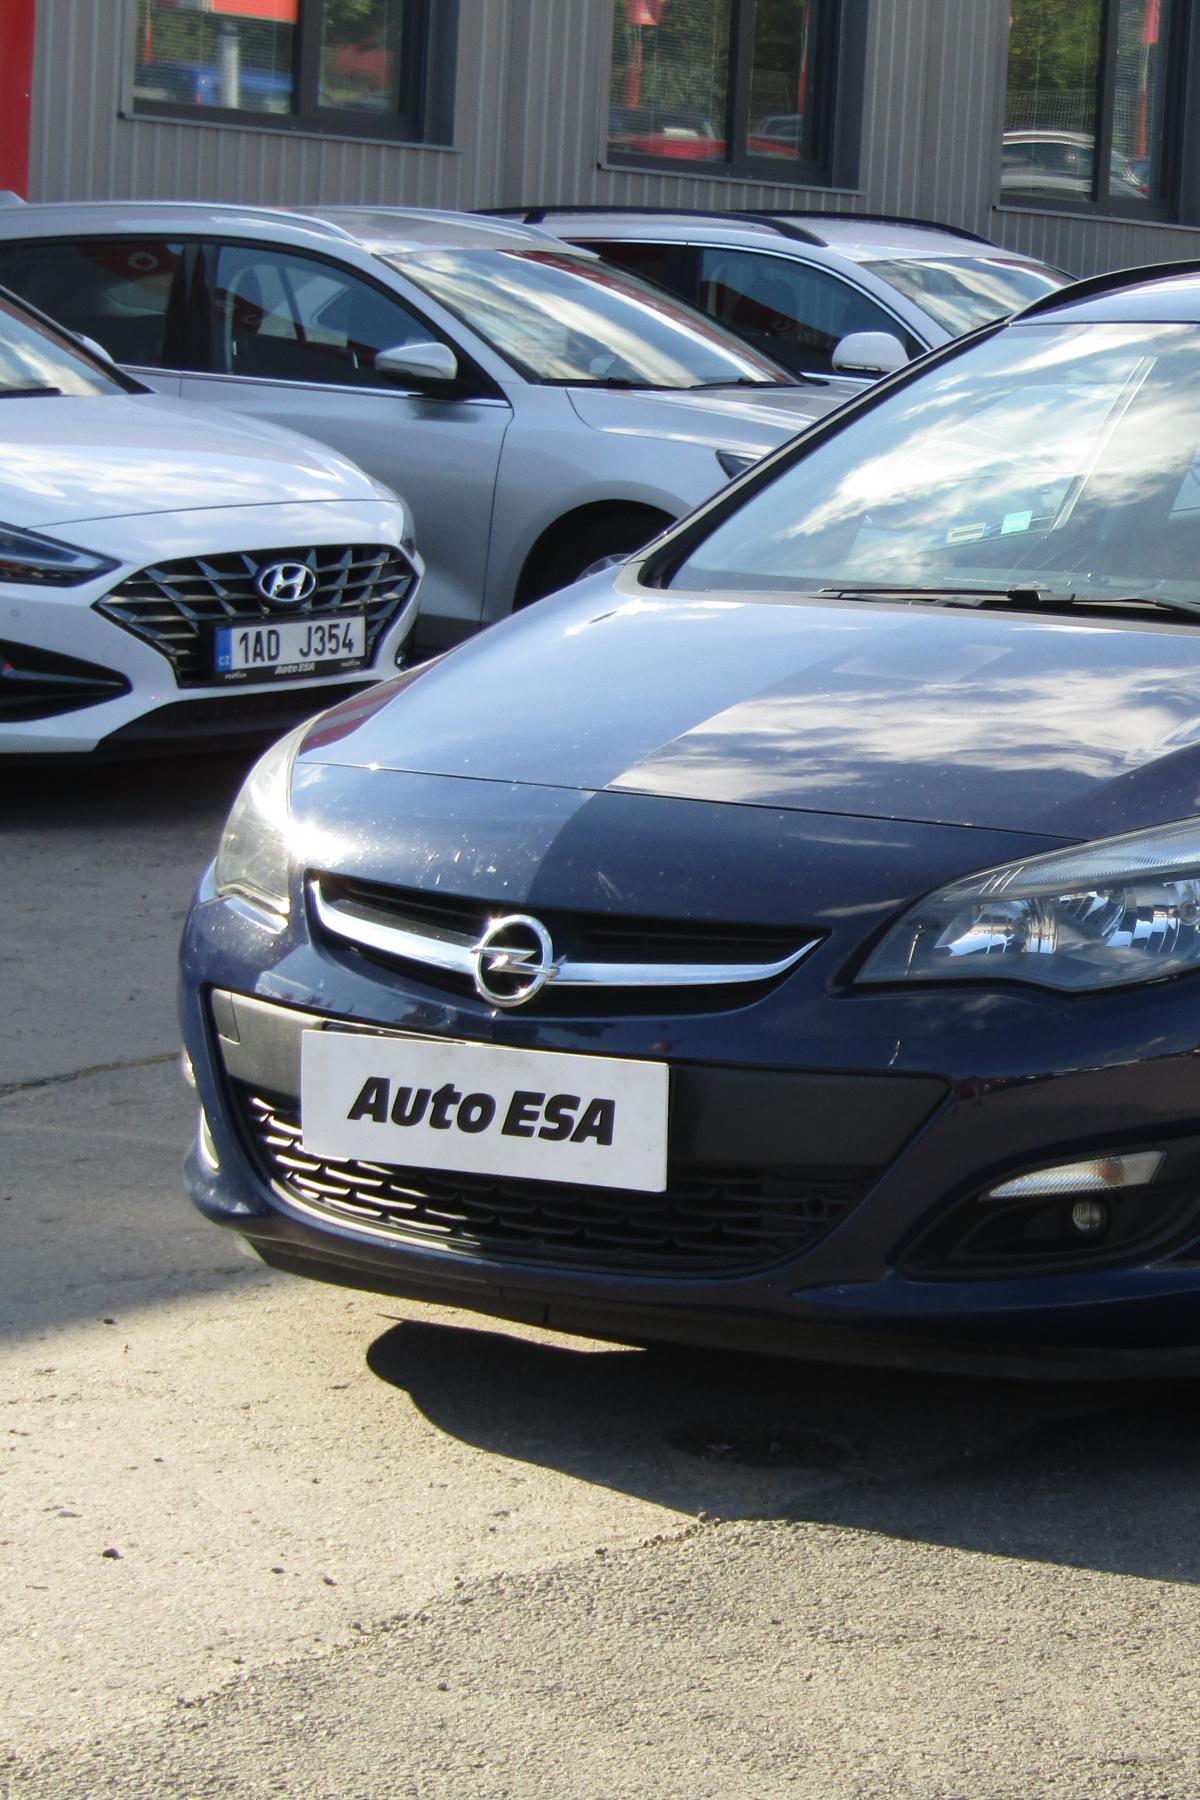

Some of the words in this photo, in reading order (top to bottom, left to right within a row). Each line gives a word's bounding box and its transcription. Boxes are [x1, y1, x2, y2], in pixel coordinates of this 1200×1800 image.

[239, 629, 281, 664] 1AD
[299, 622, 354, 658] J354
[218, 655, 231, 666] CZ
[274, 664, 298, 675] Auto
[298, 662, 316, 672] ESA
[347, 1076, 497, 1134] Auto
[501, 1090, 616, 1146] ESA
